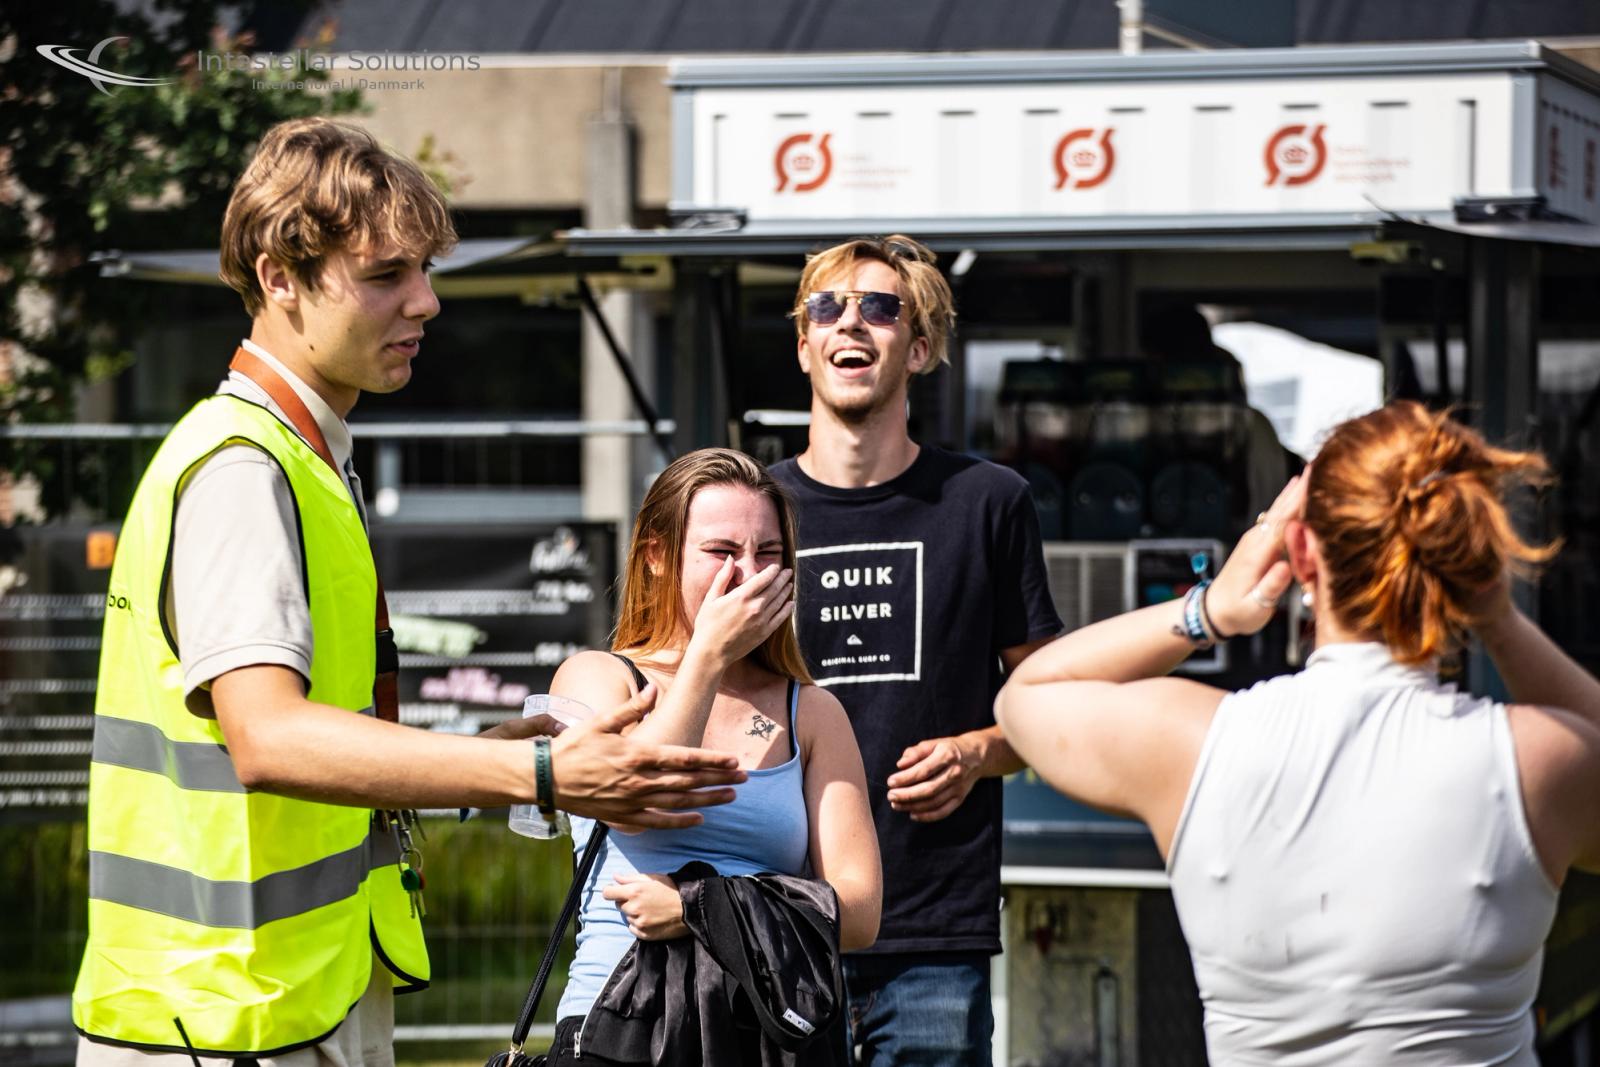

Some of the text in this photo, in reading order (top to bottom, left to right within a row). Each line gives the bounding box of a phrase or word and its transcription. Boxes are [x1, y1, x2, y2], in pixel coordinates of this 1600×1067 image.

[820, 566, 893, 589] QUIK
[820, 602, 892, 622] SILVER
[821, 653, 890, 667] ORIGINAL SURF CO
